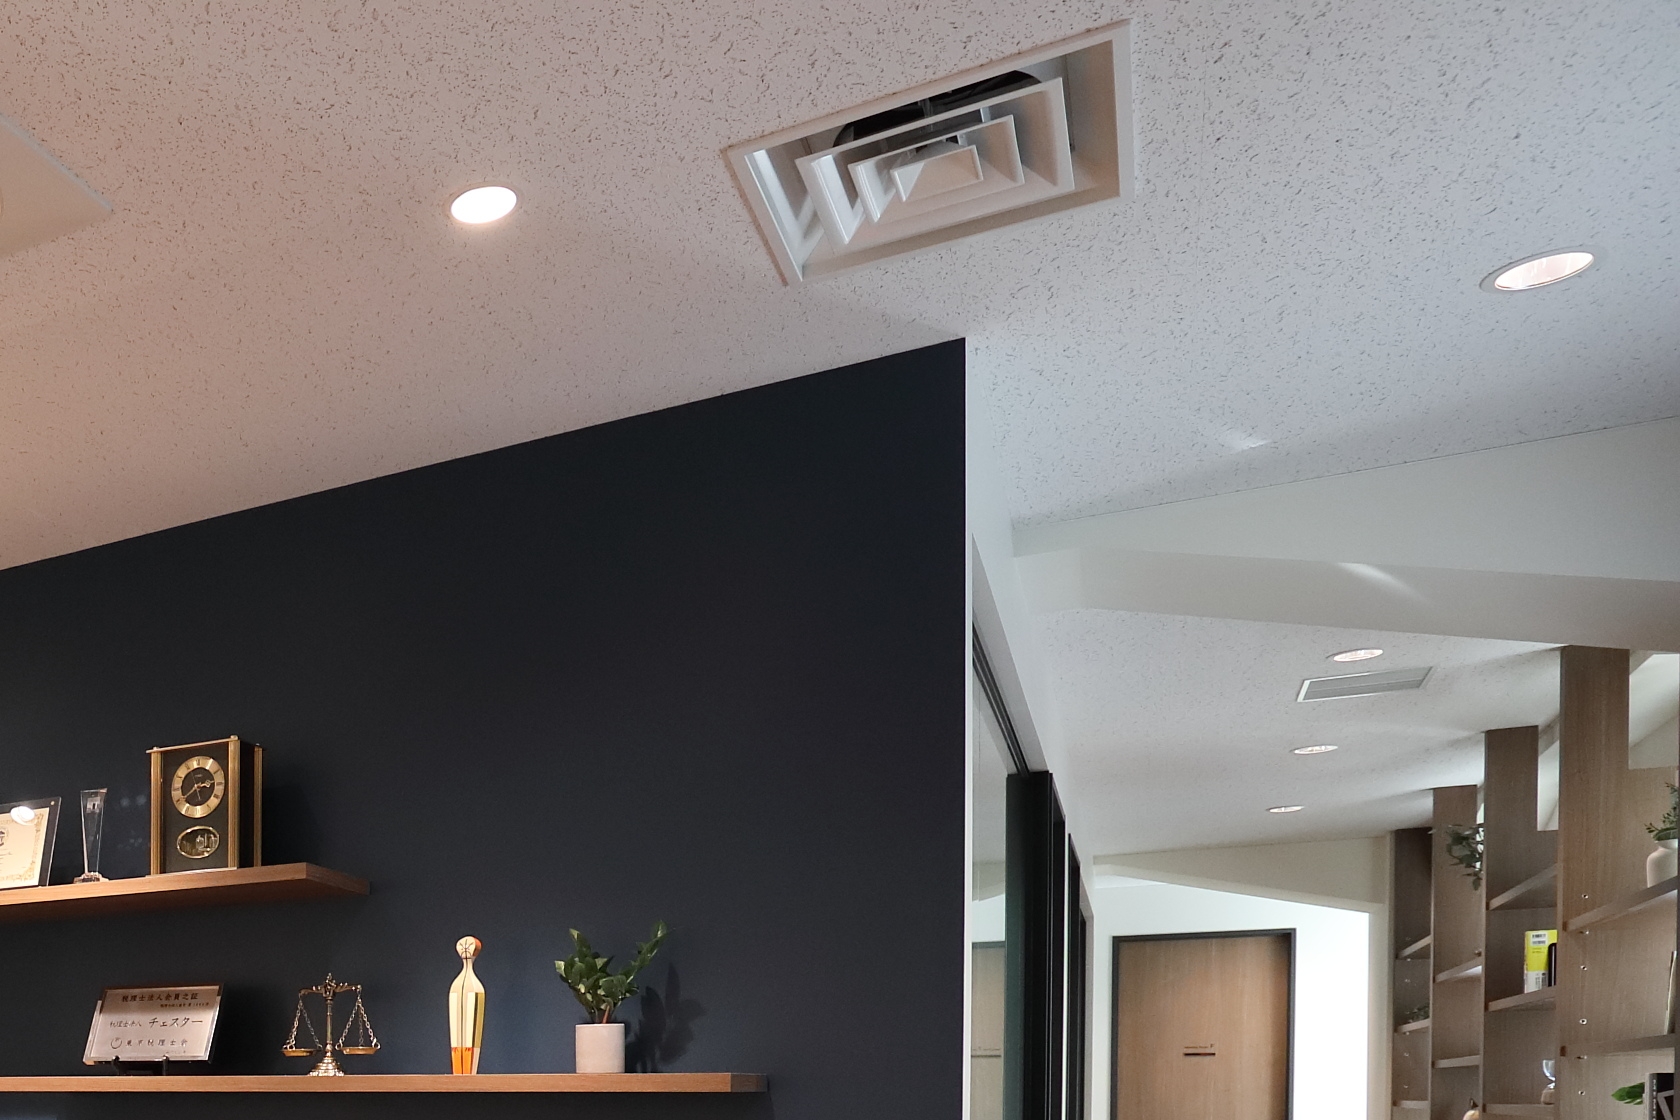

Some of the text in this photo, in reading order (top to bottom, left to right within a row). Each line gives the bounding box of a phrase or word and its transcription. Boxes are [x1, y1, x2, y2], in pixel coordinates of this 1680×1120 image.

[148, 1016, 203, 1028] チェスター
